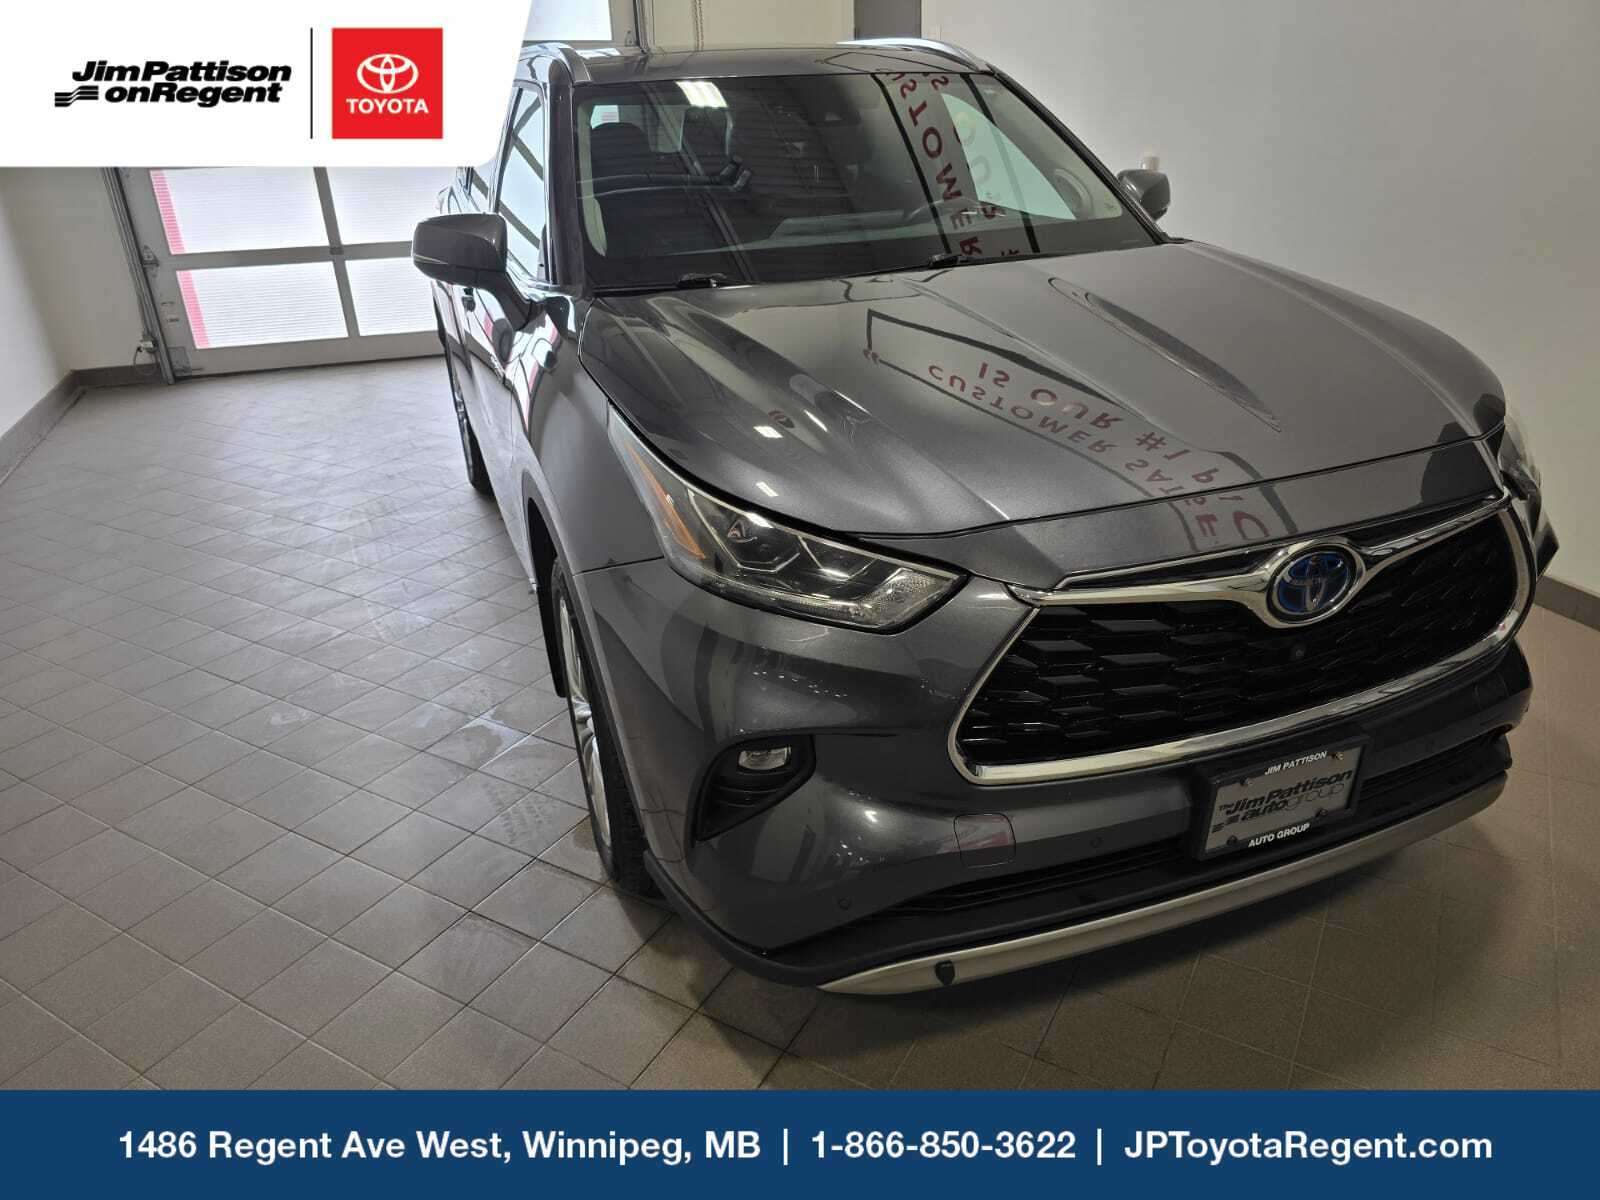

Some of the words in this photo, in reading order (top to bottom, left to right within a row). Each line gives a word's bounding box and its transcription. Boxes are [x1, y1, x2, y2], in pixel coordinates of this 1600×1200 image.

[1264, 763, 1281, 776] JIM
[1283, 751, 1328, 770] PATTISON
[1248, 833, 1275, 848] AUTO
[1276, 822, 1311, 839] GROUP
